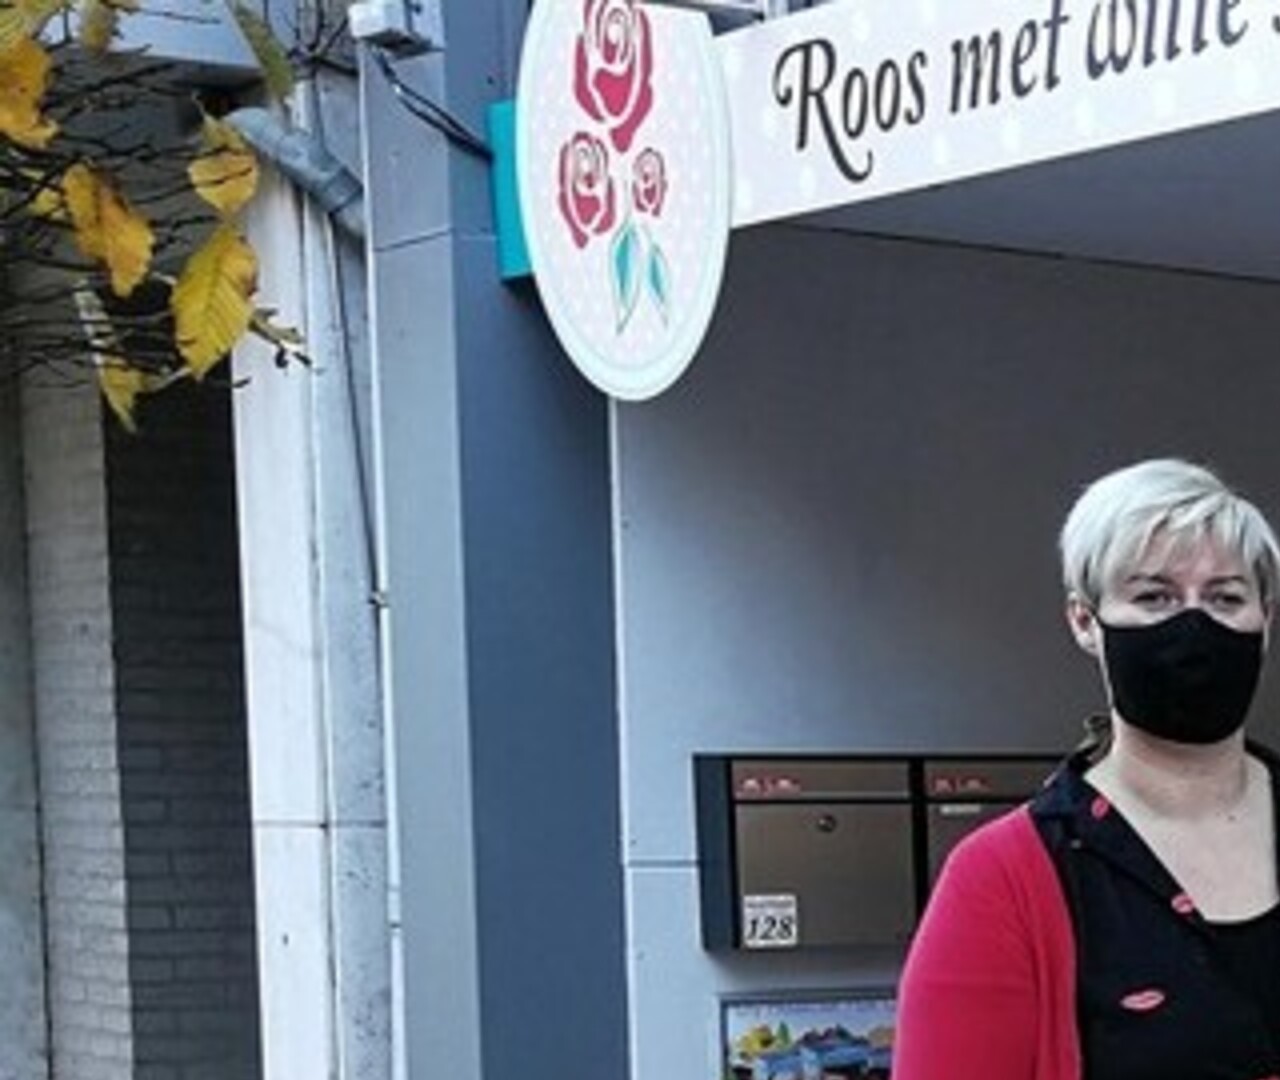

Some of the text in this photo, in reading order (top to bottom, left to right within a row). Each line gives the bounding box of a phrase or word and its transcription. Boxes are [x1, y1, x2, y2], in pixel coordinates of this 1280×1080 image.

[772, 38, 927, 182] Roos
[950, 0, 1070, 114] met
[747, 915, 794, 941] 128
